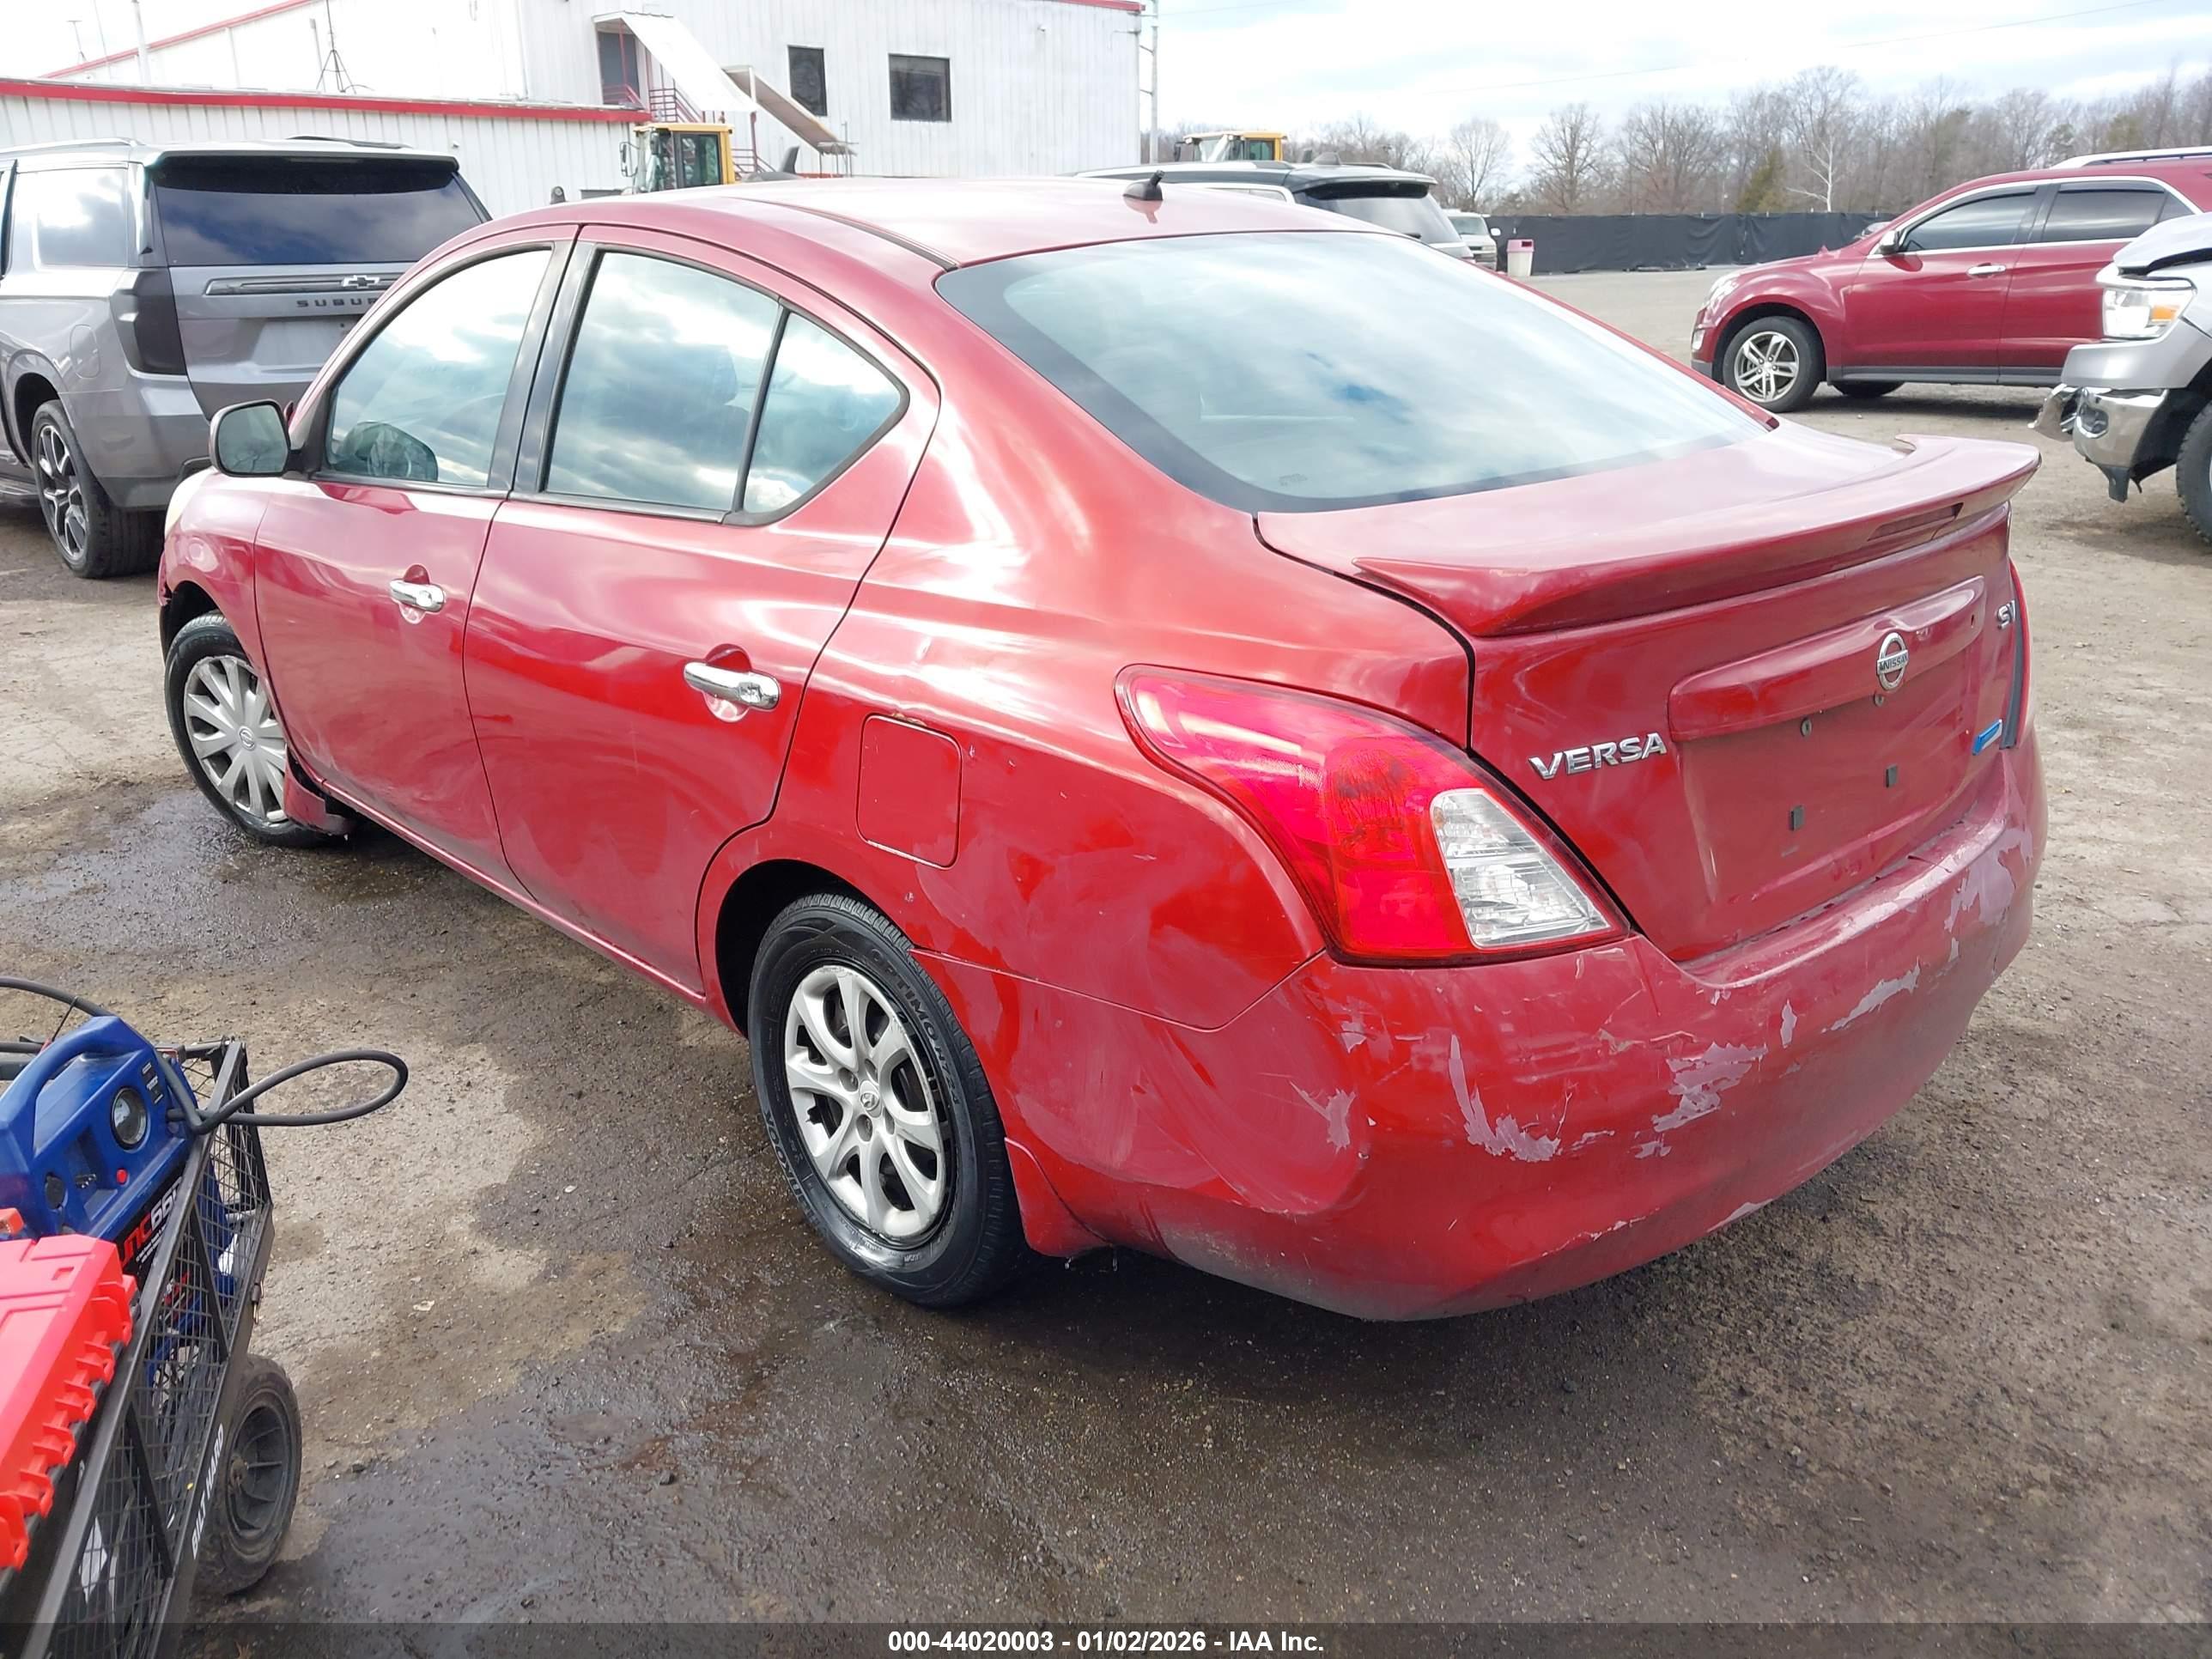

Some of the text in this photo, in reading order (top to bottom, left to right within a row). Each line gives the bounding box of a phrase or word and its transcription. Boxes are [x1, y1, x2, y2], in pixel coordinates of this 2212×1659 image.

[1882, 653, 1908, 670] NISSAN
[1528, 732, 1667, 780] VERSA
[191, 1422, 224, 1559] BILT HARD
